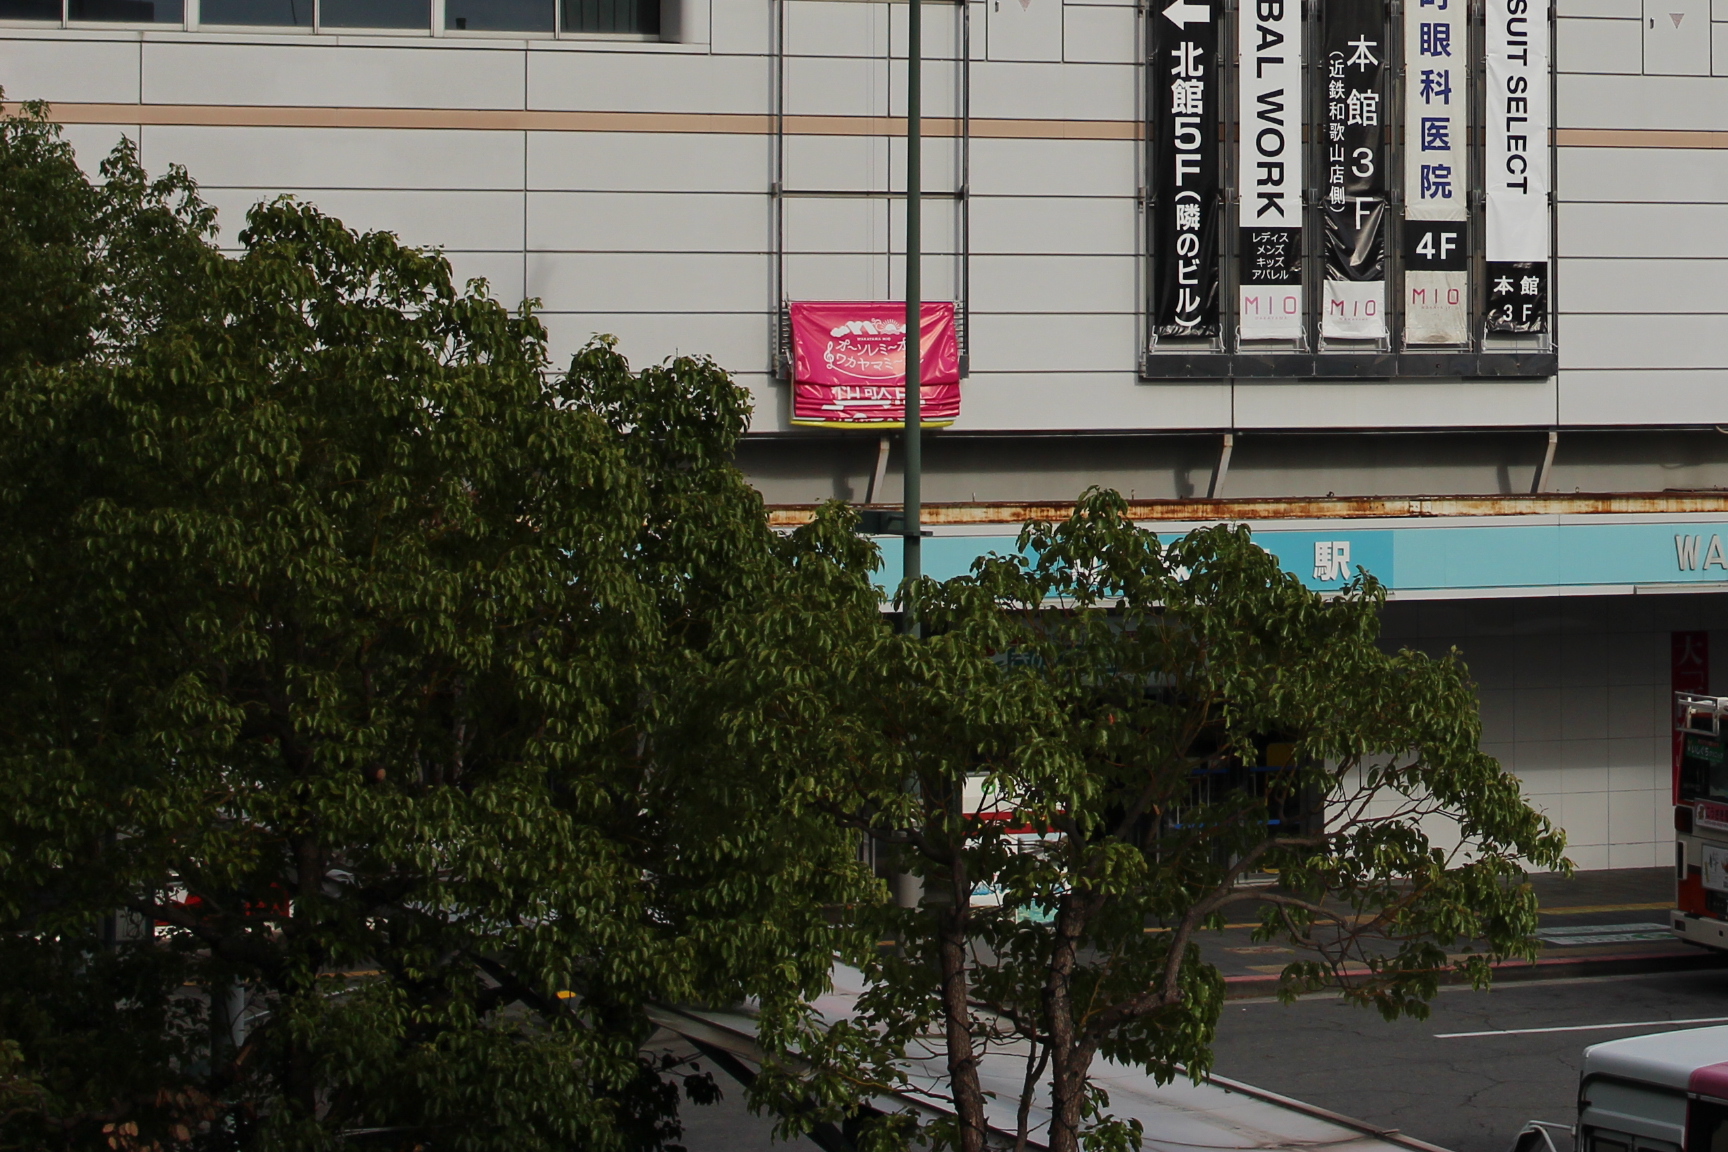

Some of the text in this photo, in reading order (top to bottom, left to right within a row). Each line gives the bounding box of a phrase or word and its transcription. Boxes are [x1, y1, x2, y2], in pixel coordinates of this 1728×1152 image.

[1505, 76, 1528, 195] SELECT
[1256, 87, 1286, 218] WORK
[1252, 232, 1289, 243] レディス
[1416, 231, 1457, 260] 4F
[1256, 244, 1285, 255] メンズ
[1256, 256, 1285, 268] キッズ
[1252, 269, 1289, 280] アパレル
[1493, 275, 1540, 296] 本館
[1412, 288, 1460, 305] MIO
[1245, 296, 1297, 315] MIO
[1330, 299, 1376, 316] MIO
